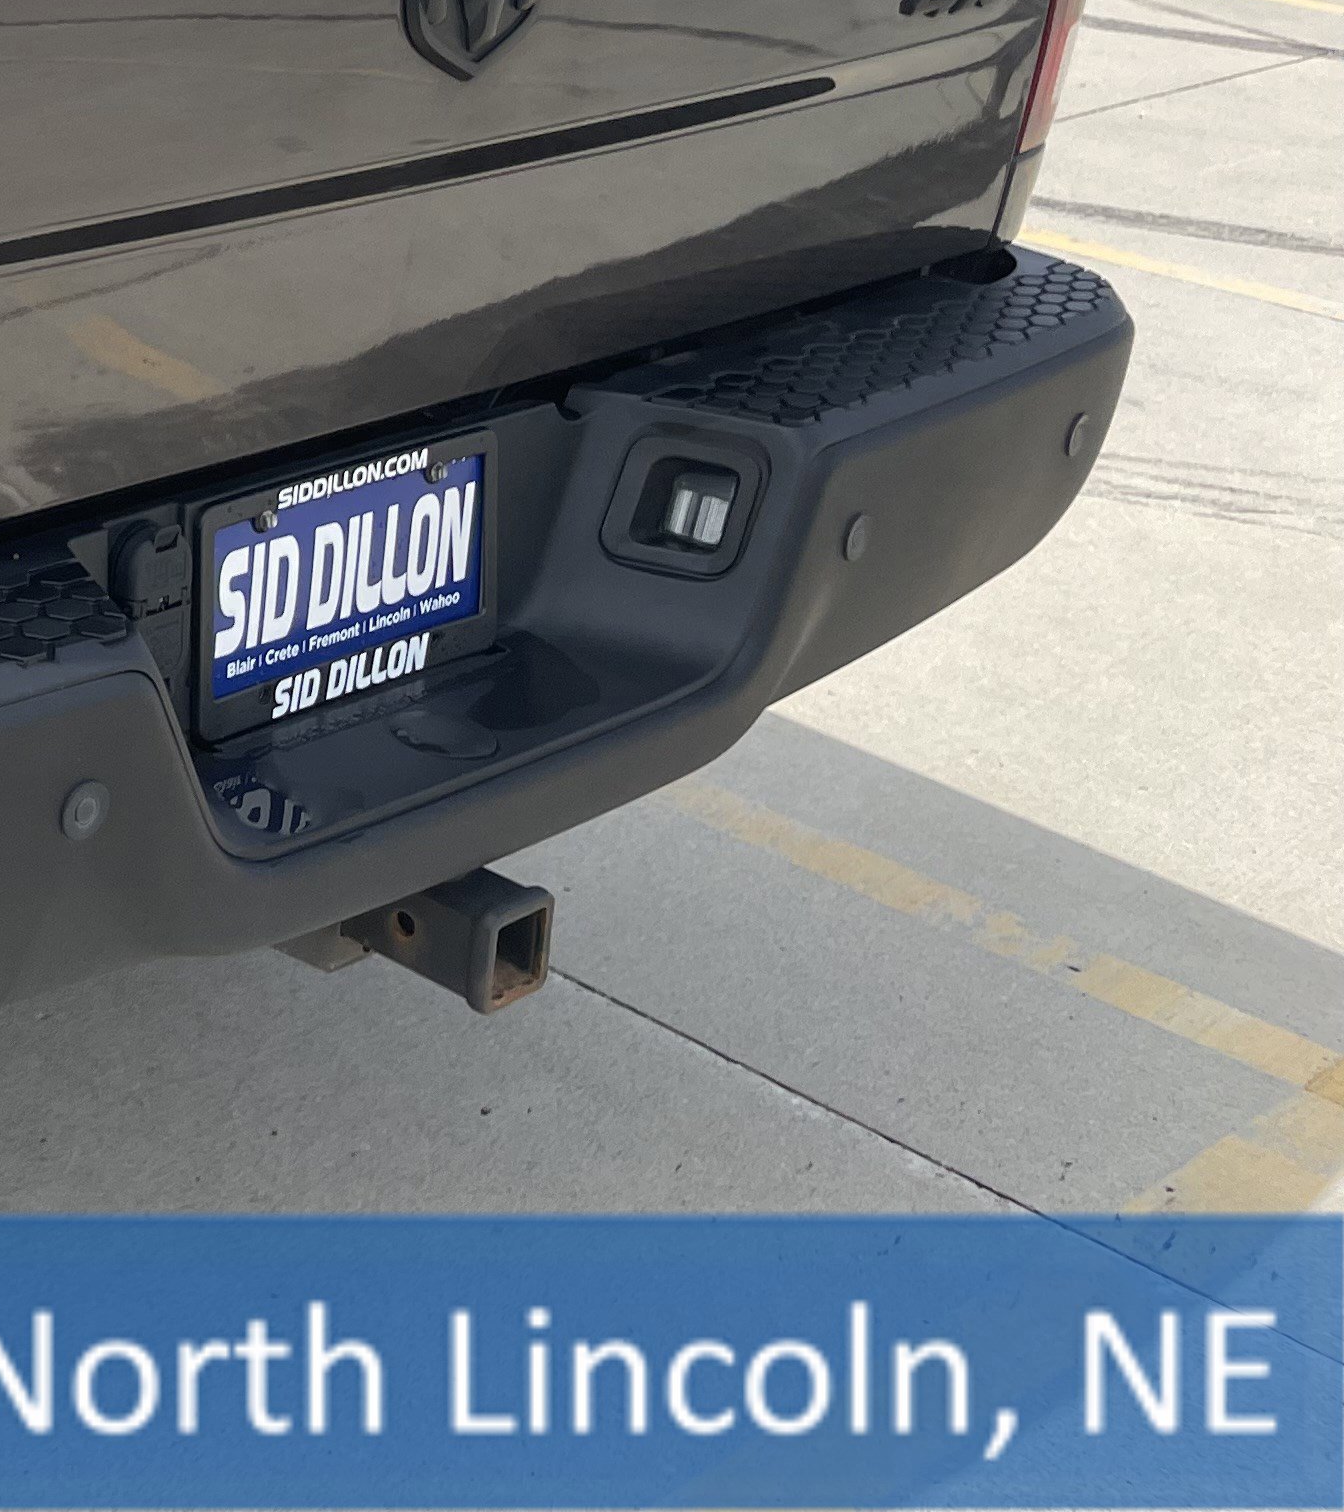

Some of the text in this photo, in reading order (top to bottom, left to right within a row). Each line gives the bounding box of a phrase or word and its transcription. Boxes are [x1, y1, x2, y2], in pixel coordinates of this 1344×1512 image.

[277, 447, 429, 510] SIDDILLON.COM
[213, 480, 477, 659] SID DILLON
[226, 591, 461, 679] Blair Crete Fremont Lincoln Wahoo
[272, 632, 430, 720] SID DILLON
